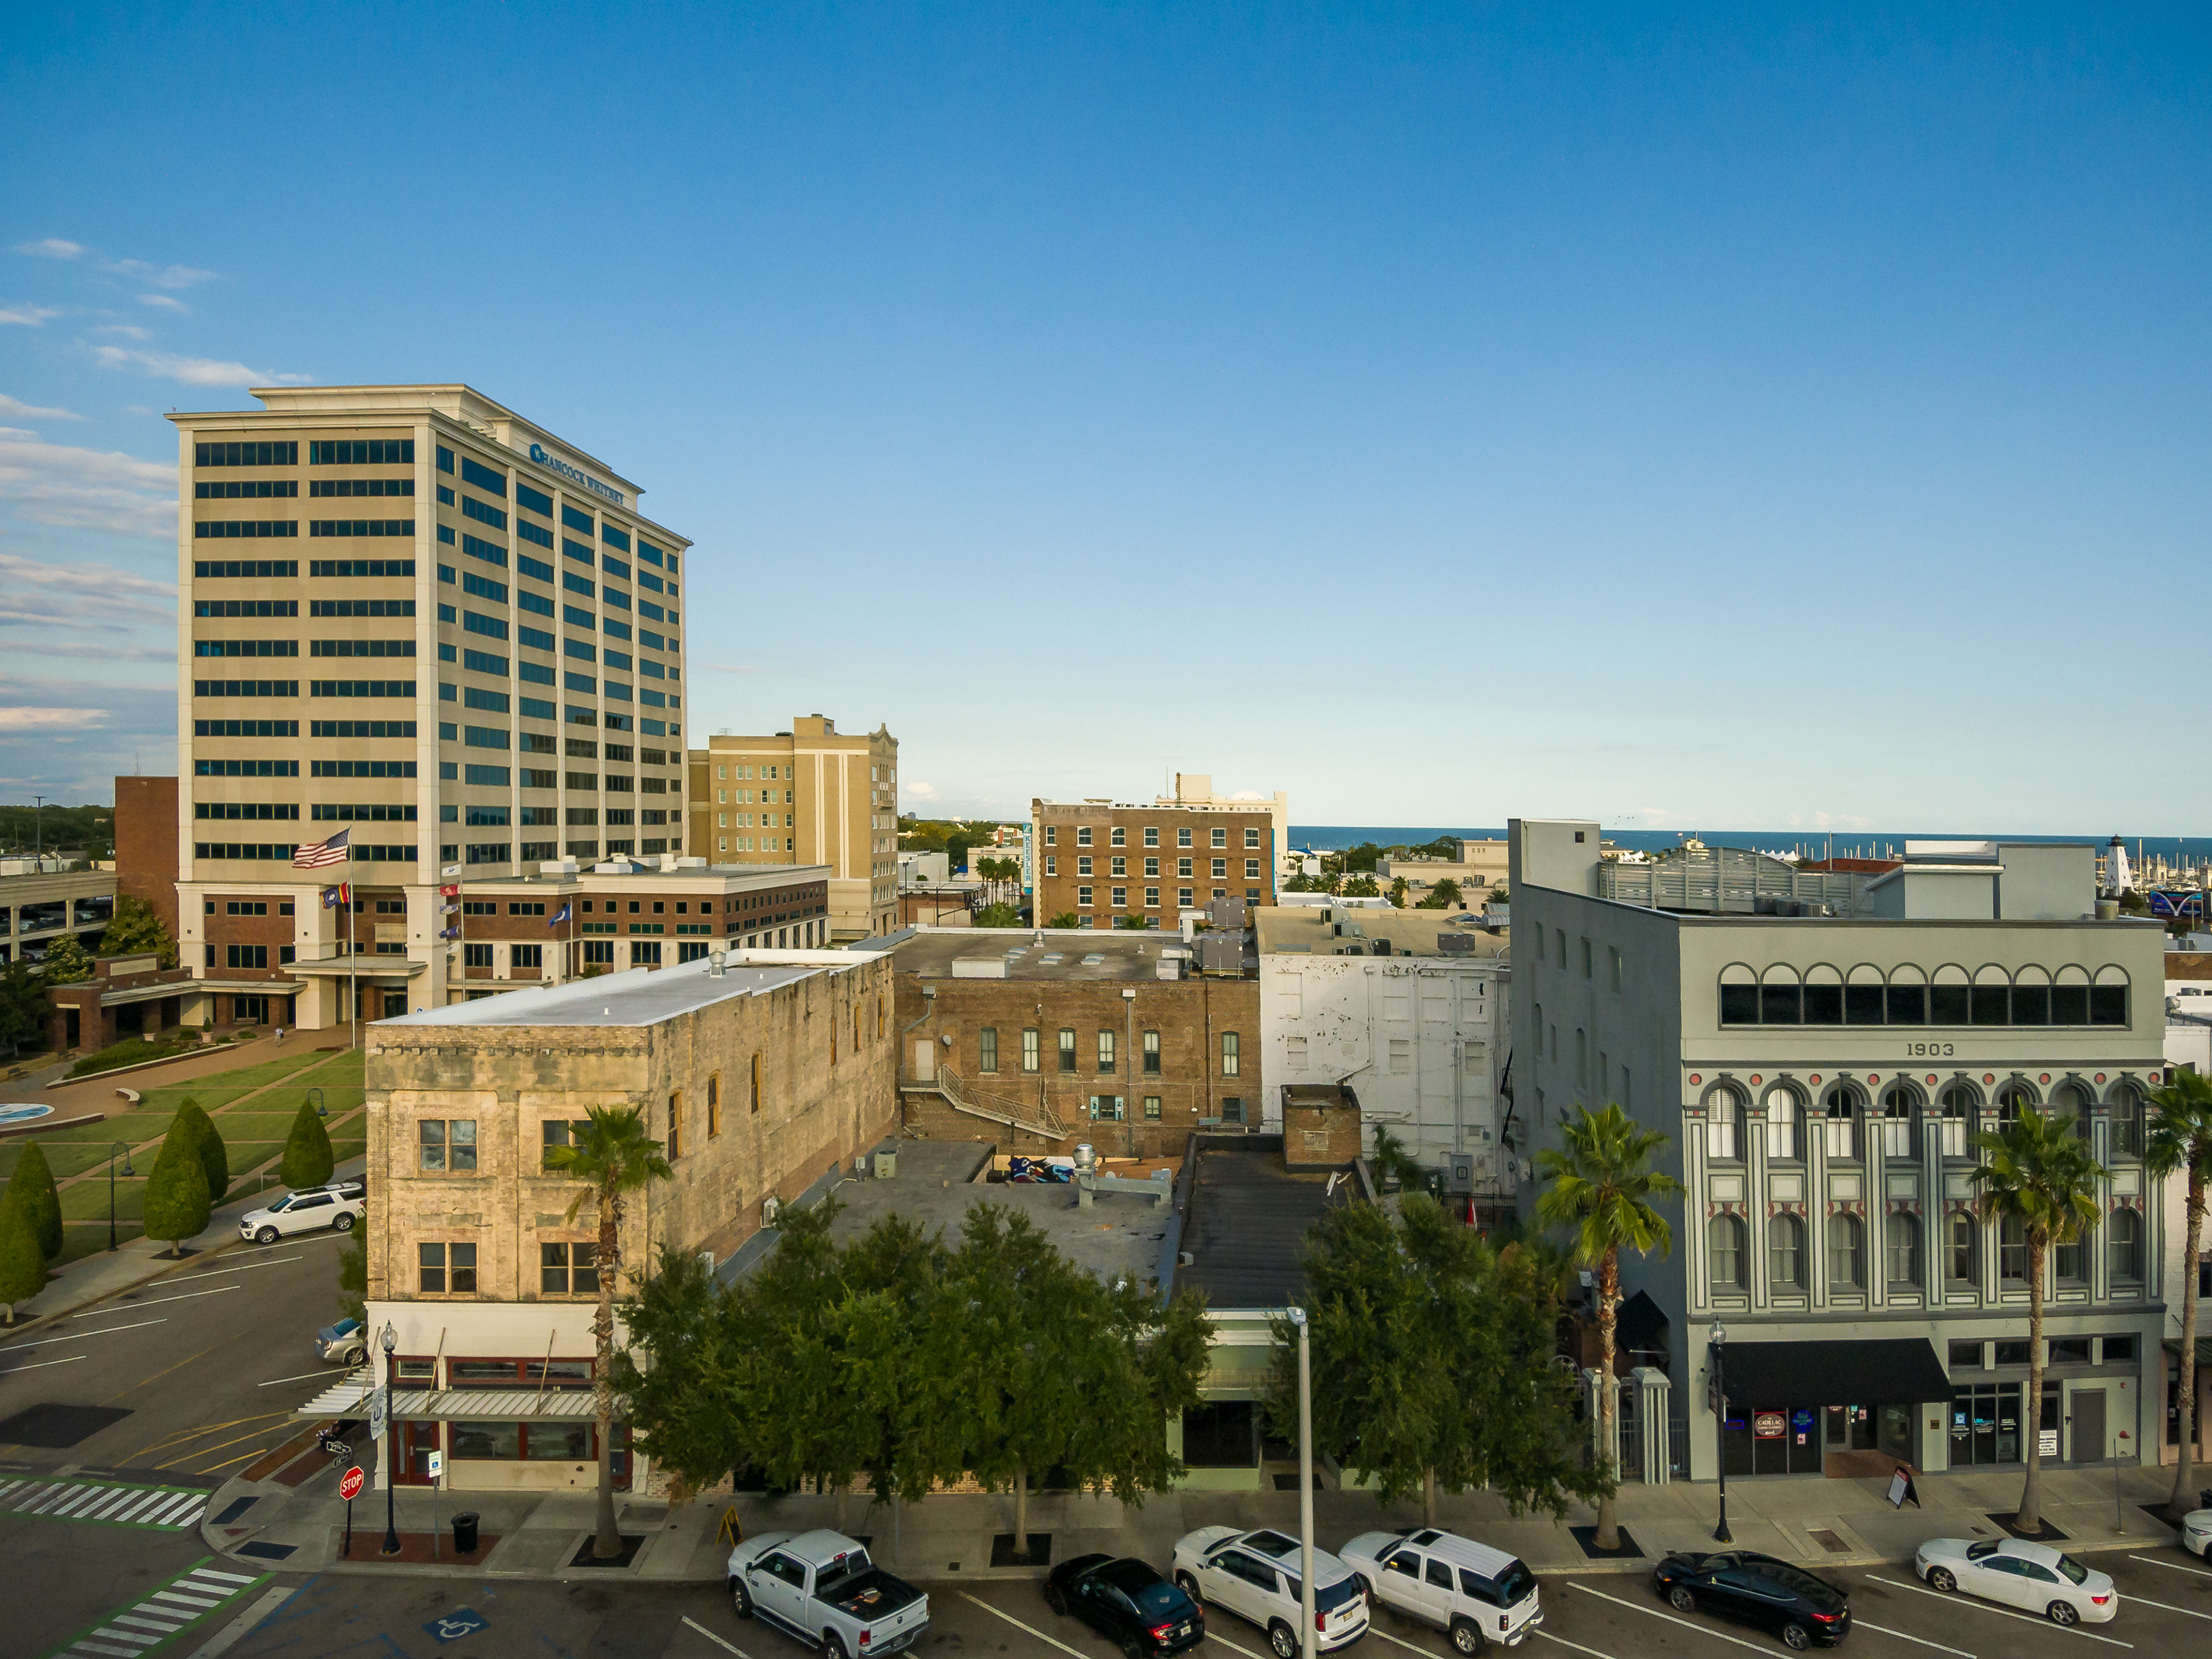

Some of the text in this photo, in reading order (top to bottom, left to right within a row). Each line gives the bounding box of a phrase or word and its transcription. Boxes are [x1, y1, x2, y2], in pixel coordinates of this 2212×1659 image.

[542, 452, 624, 505] HANCOCK WHITNEY
[1907, 1043, 1954, 1056] 1903
[342, 1474, 362, 1493] STOP
